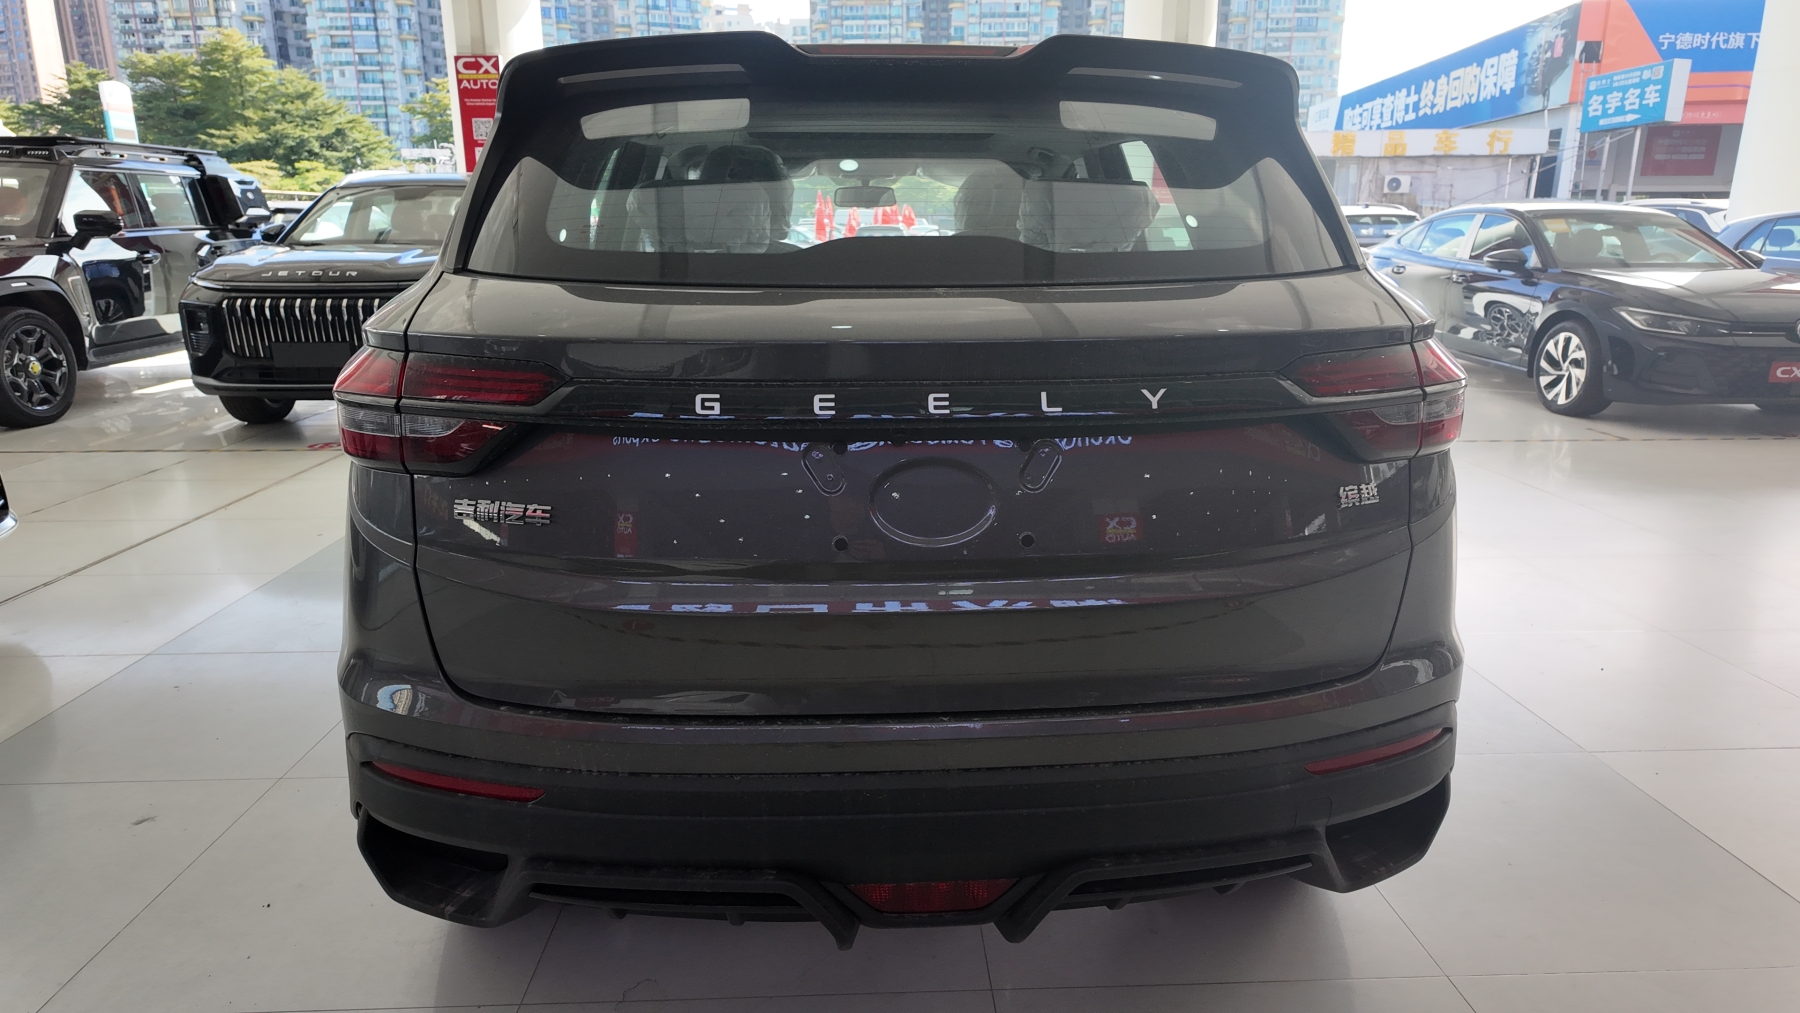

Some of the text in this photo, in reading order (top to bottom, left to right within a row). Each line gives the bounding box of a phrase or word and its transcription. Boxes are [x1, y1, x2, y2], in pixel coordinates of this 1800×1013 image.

[1658, 32, 1761, 50] 宁德时代旗下
[456, 57, 499, 75] CX
[460, 79, 499, 90] AUTO
[1418, 48, 1519, 117] 终身回购保障
[1587, 84, 1662, 118] 名宇名车
[1331, 129, 1514, 156] 精品车行
[1776, 366, 1800, 378] CX
[694, 388, 1168, 415] GEELY
[1339, 483, 1380, 508] 缤越
[453, 498, 552, 527] 吉利汽车
